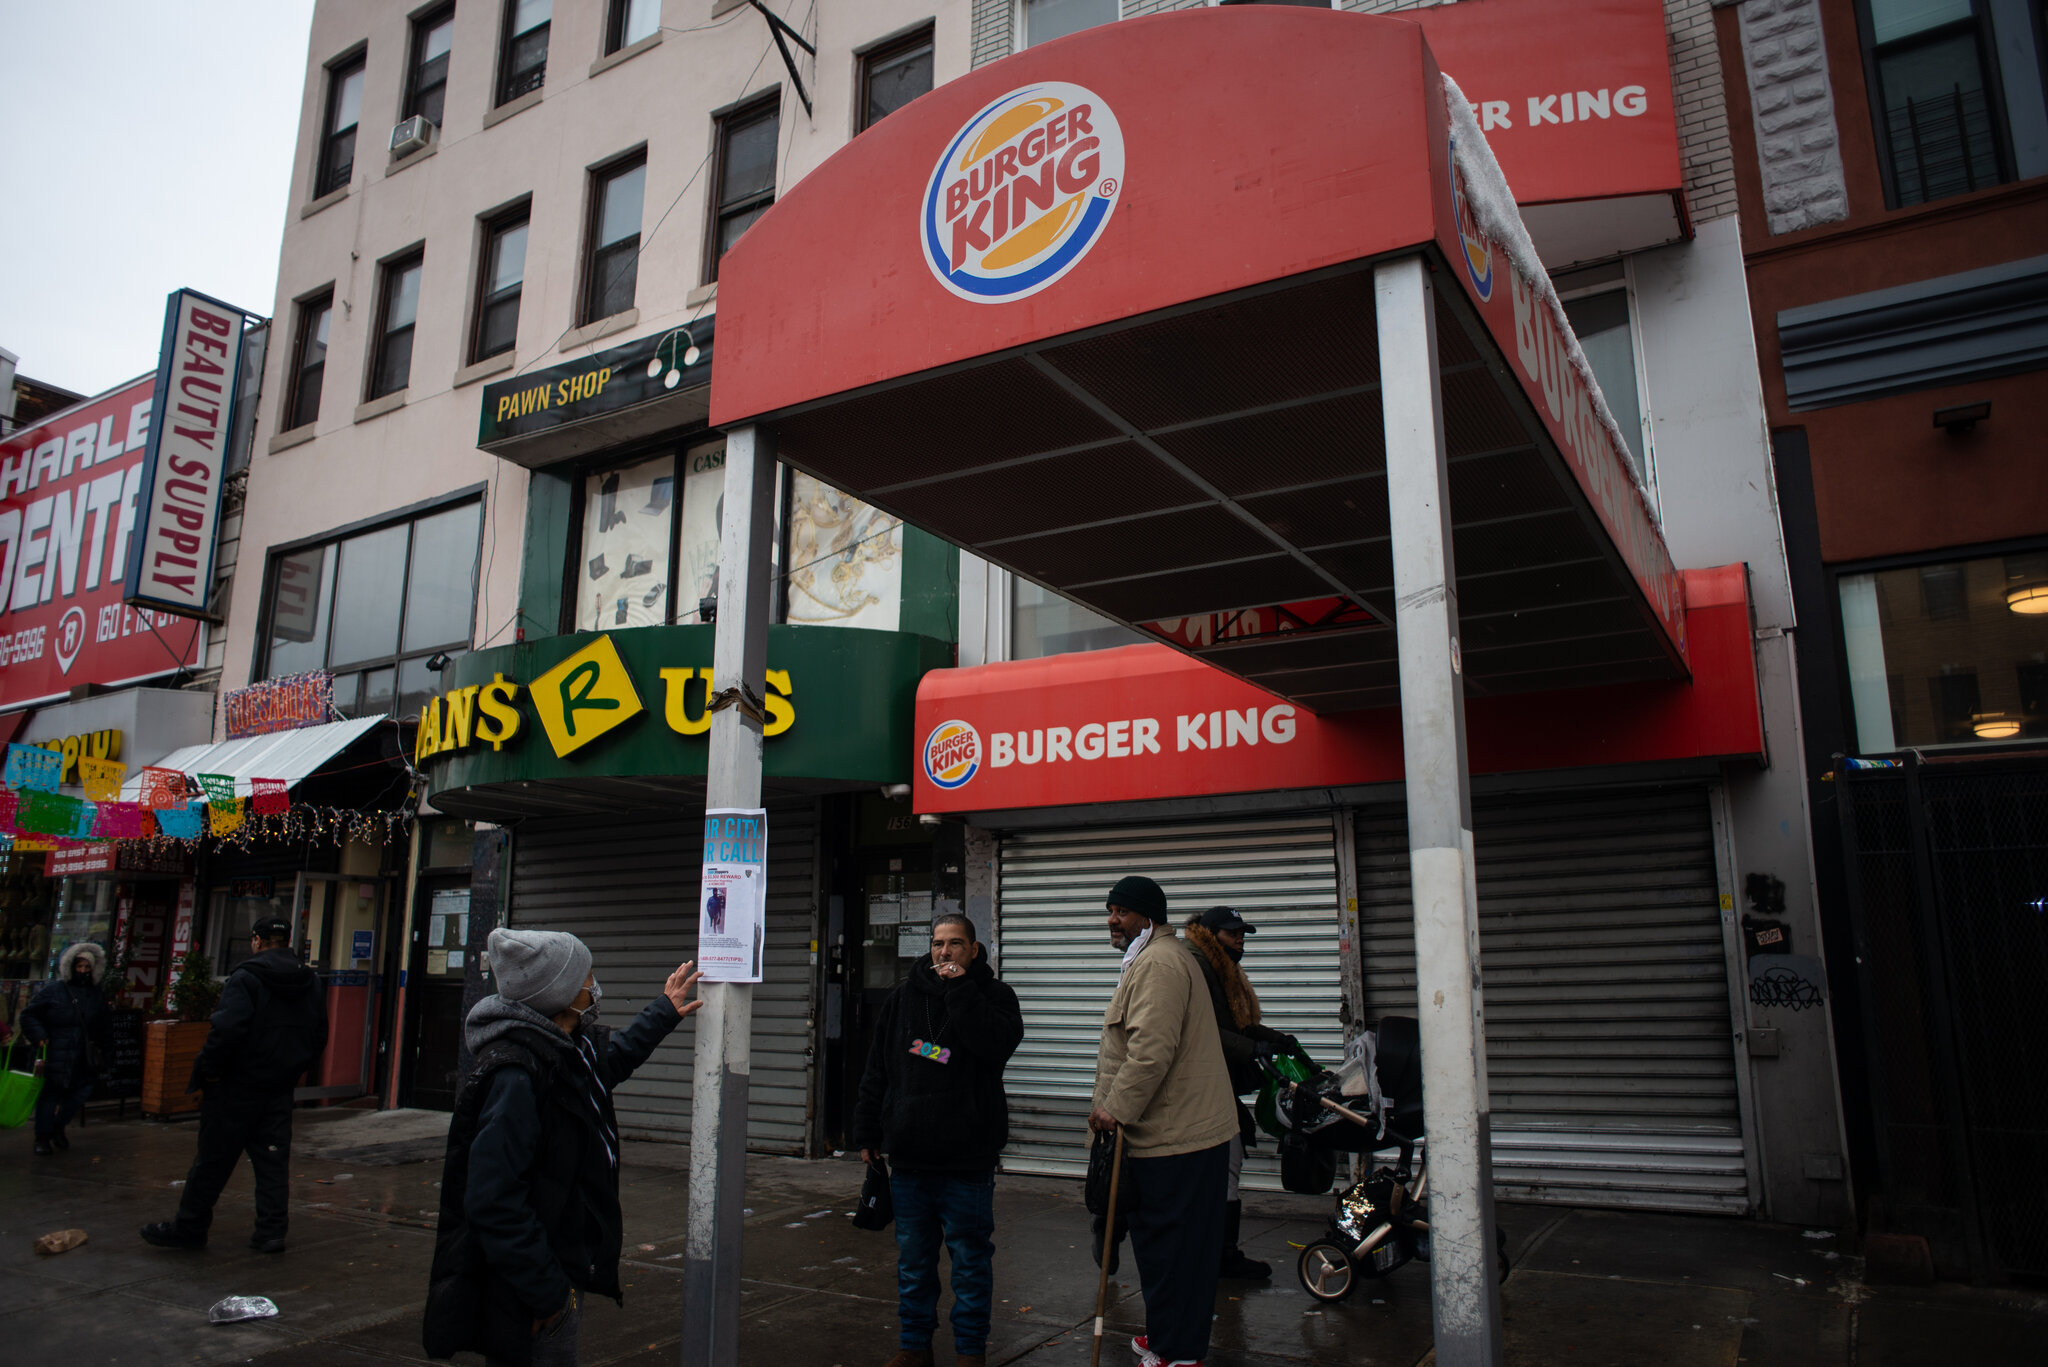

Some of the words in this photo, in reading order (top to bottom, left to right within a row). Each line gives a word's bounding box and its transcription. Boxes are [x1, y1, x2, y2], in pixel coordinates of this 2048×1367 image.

[1527, 85, 1648, 127] KING
[945, 103, 1094, 224] BURGER
[951, 136, 1101, 273] KING
[173, 305, 231, 451] BEAUTY
[496, 383, 551, 423] PAWN
[555, 367, 611, 407] SHOP
[151, 454, 211, 597] SUPPLY
[96, 603, 121, 643] 160
[229, 680, 323, 734] QUESADILLAS
[560, 661, 620, 737] R
[659, 667, 796, 737] US
[930, 730, 974, 760] BURGER
[931, 742, 976, 777] KING
[989, 718, 1161, 768] BURGER
[1176, 704, 1297, 752] KING
[720, 842, 762, 863] CALL.
[724, 818, 762, 839] CITY.
[909, 1038, 951, 1064] 2022
